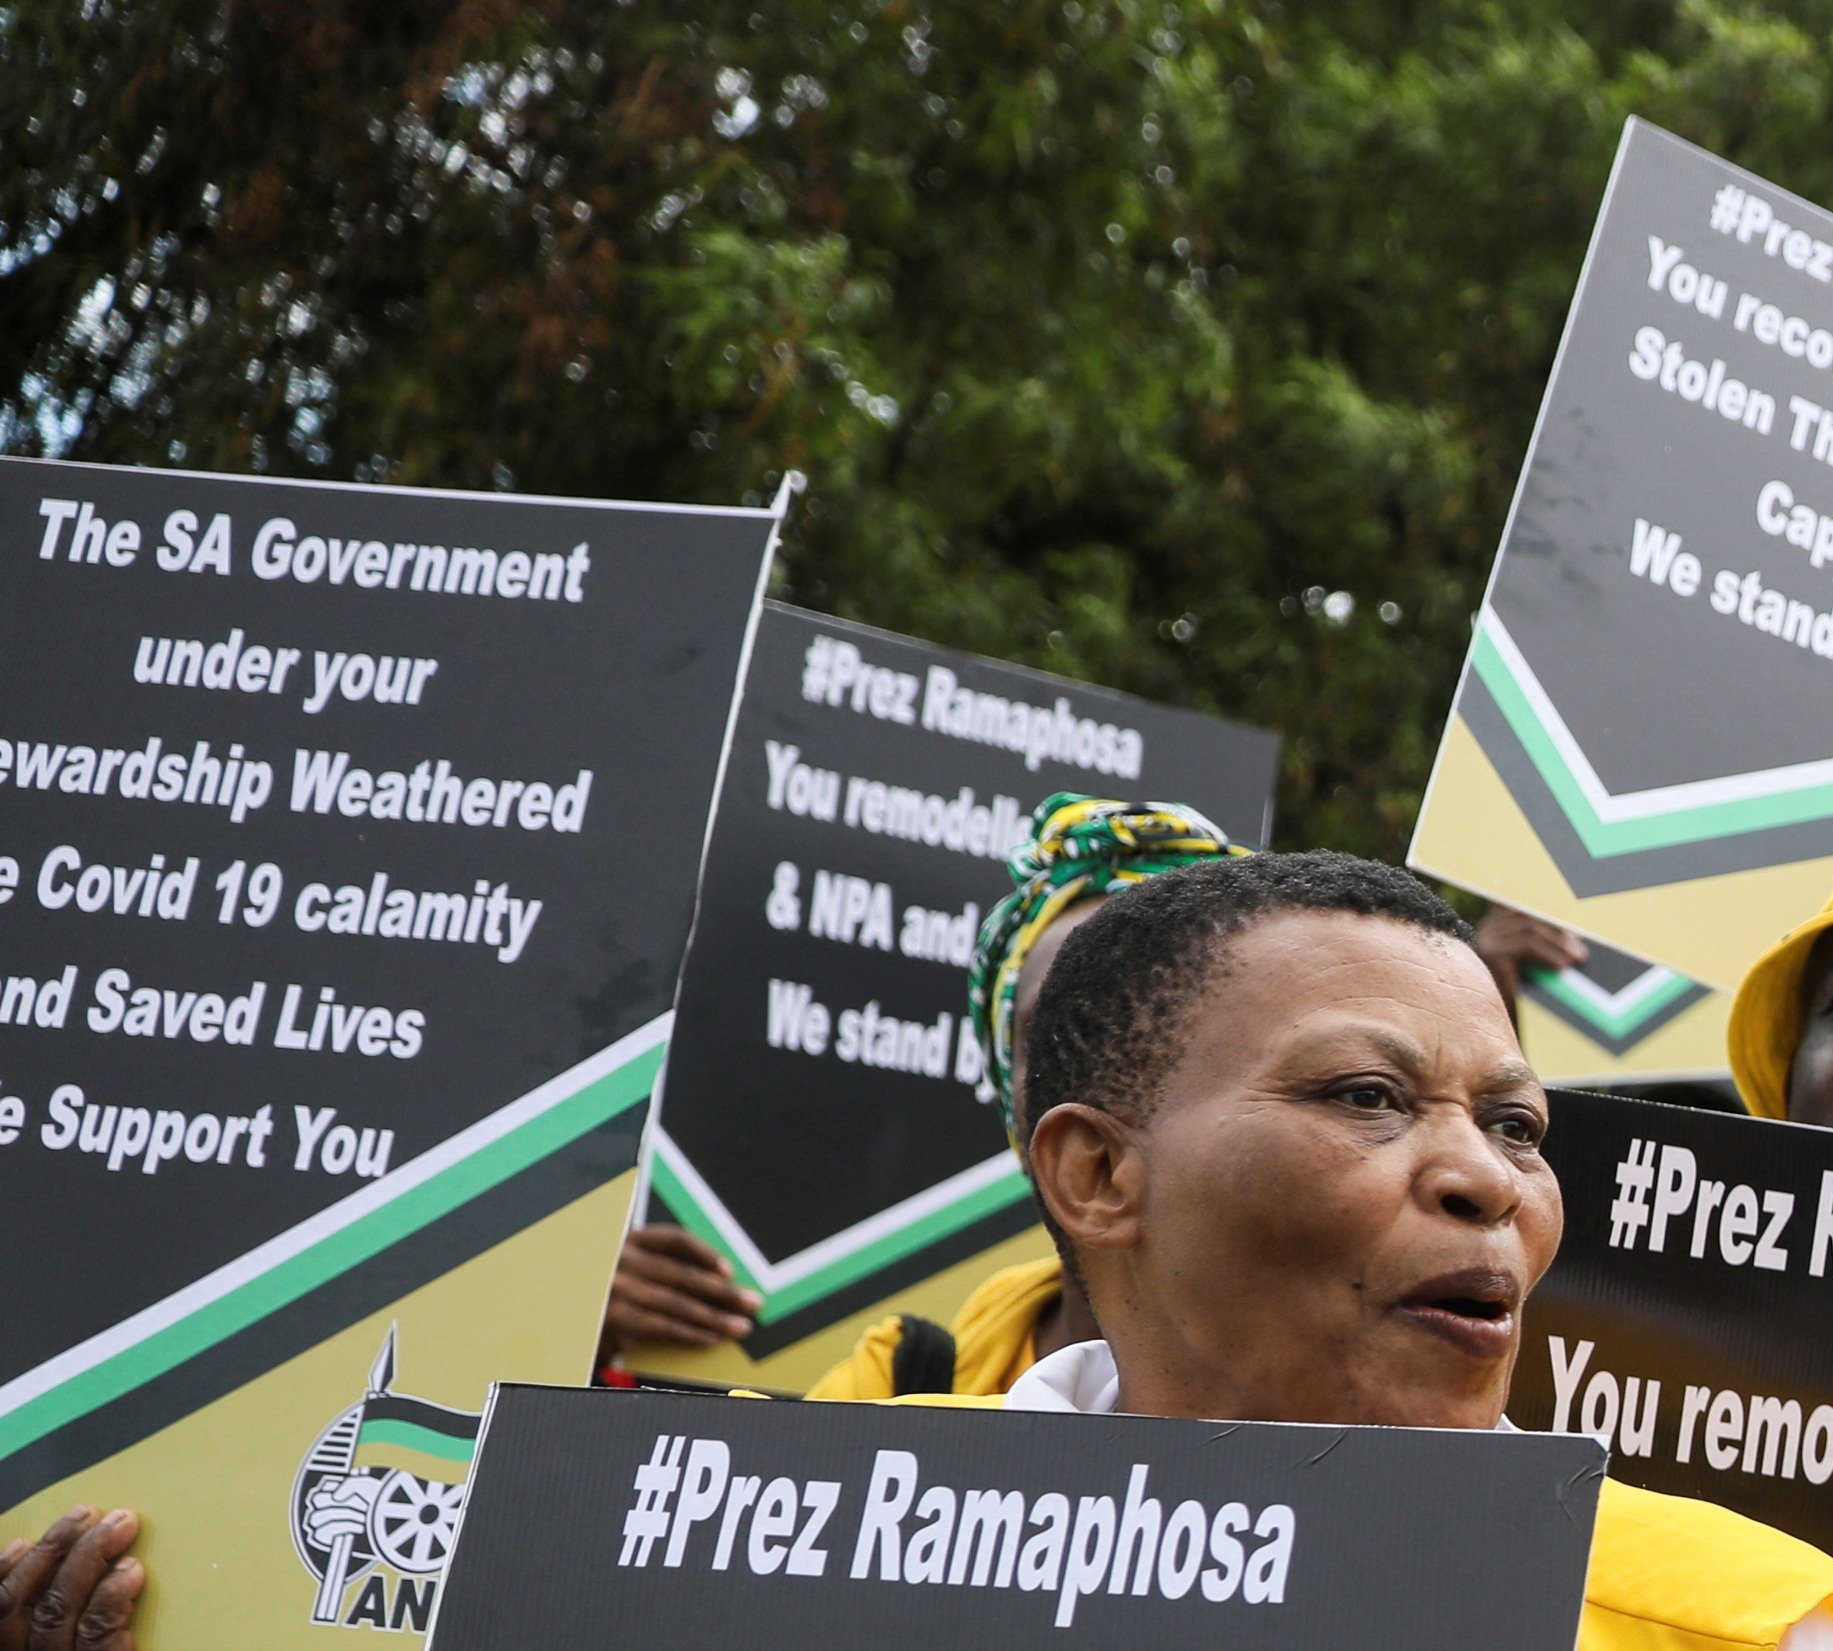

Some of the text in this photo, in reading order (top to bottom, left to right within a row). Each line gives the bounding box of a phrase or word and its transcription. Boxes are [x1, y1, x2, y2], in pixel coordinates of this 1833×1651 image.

[1648, 235, 1728, 319] You
[1629, 326, 1775, 435] Stolen
[40, 499, 590, 602] The SA Government
[1630, 518, 1701, 596] We
[134, 629, 437, 713] under your
[803, 637, 1142, 778] #Prez Ramaphosa
[291, 750, 592, 832] Weathered
[767, 741, 839, 820] You
[38, 846, 199, 919] Covid
[216, 861, 281, 926] 19
[295, 873, 542, 962] calamity
[768, 863, 980, 969] & NPA and
[0, 966, 425, 1058] nd Saved Lives
[769, 980, 828, 1053] We
[837, 1004, 950, 1076] stand
[0, 1078, 394, 1178] e Support You
[1609, 1139, 1794, 1270] #Prez
[1548, 1335, 1661, 1457] You
[618, 1435, 1295, 1627] #Prez Ramaphosa
[346, 1576, 436, 1631] AN
